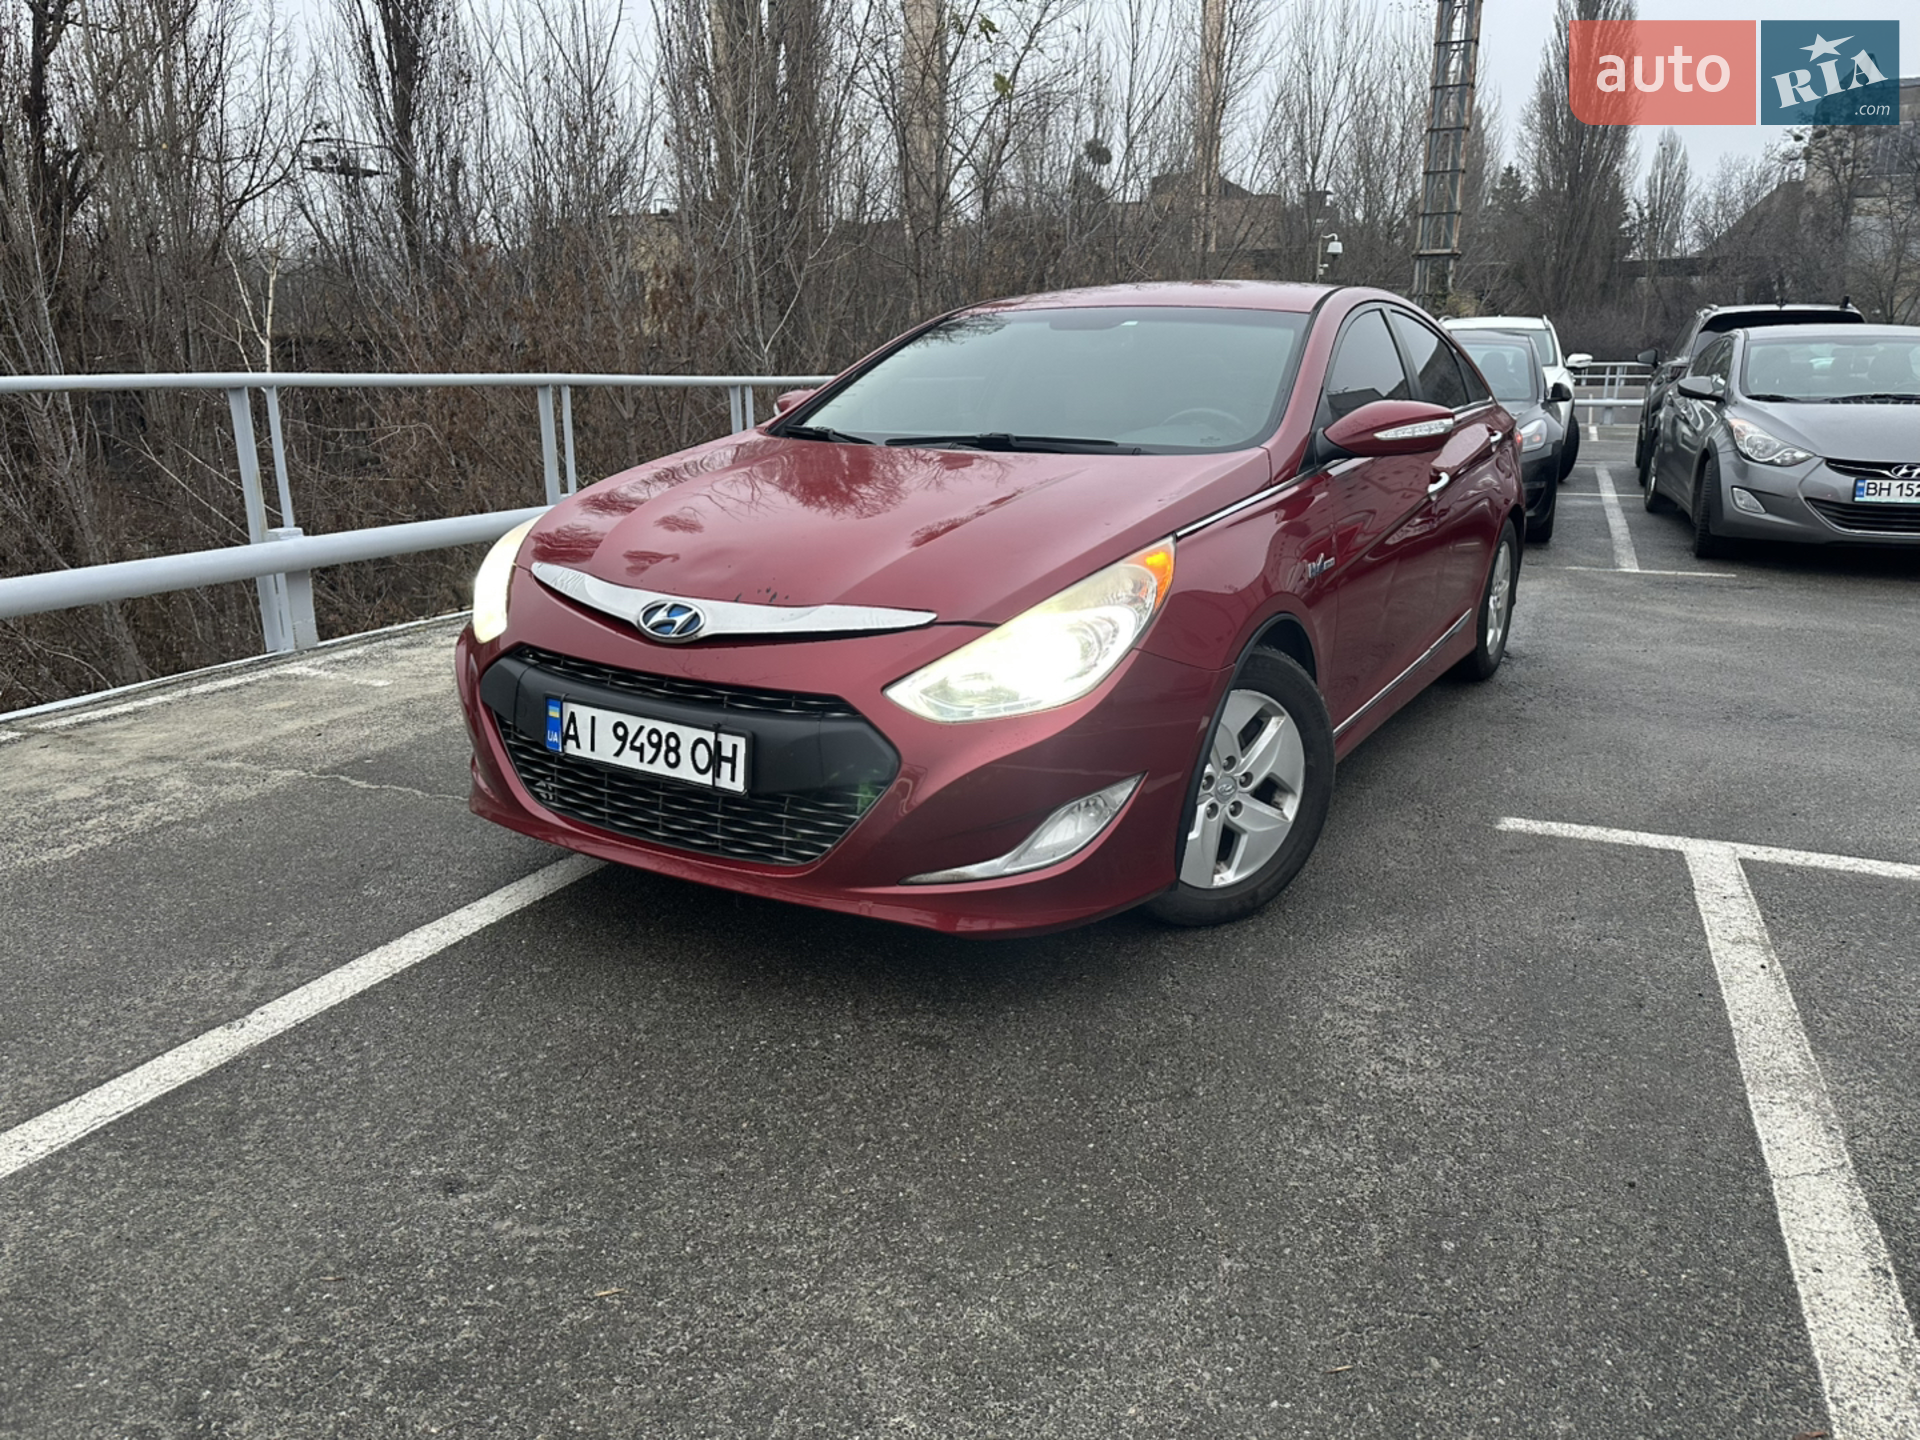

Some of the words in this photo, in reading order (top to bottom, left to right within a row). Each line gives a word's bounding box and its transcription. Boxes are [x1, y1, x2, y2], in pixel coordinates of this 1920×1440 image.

[1866, 482, 1891, 497] BH
[547, 729, 559, 743] UA
[563, 710, 596, 752] AI
[612, 720, 681, 769] 9498
[691, 736, 738, 783] OH
